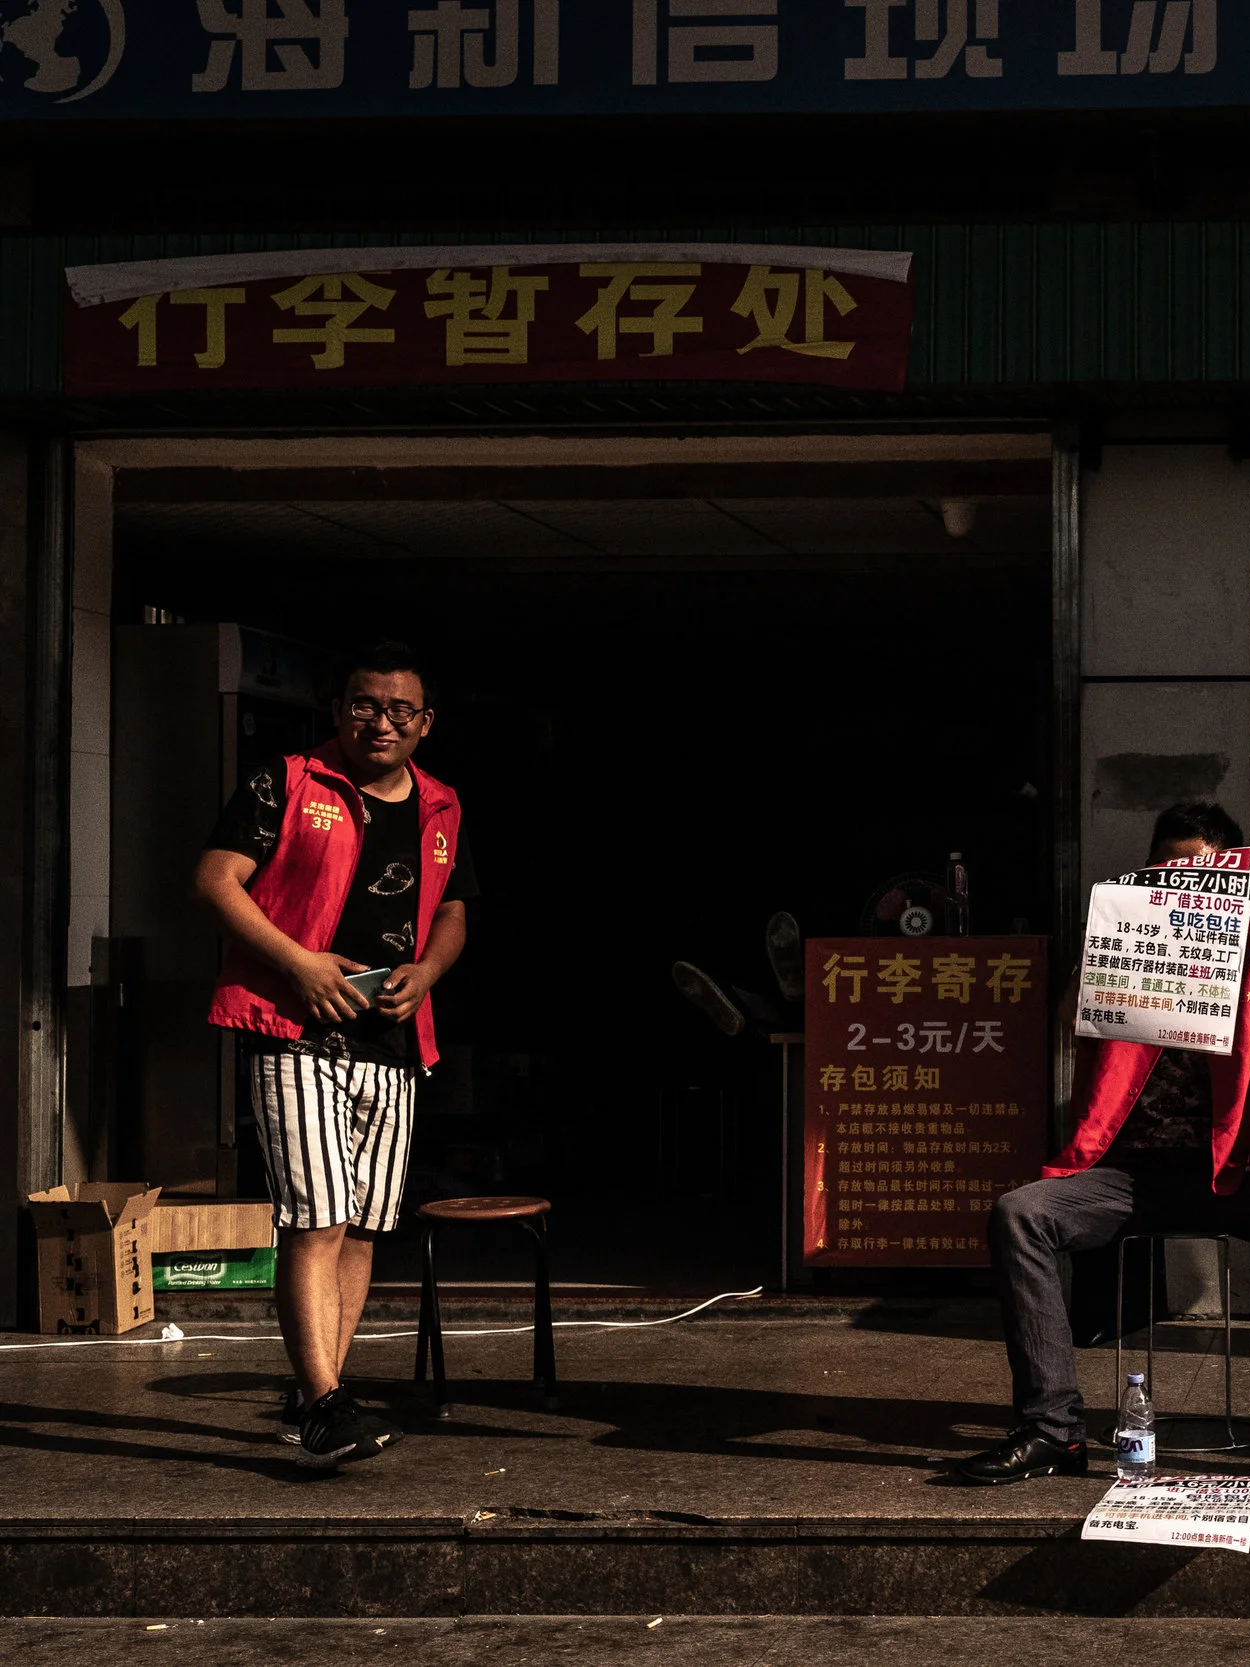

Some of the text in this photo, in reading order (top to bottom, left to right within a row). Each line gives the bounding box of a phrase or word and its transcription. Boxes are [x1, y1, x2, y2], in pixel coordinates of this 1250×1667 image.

[117, 260, 857, 370] 行李暂存处
[311, 816, 332, 831] 33
[1104, 870, 1248, 897] 价：16元/小时
[1150, 890, 1244, 915] 进厂借支100元
[1116, 921, 1240, 947] 18-45岁，本人证件有磁
[1169, 909, 1242, 934] 包吃包住
[821, 952, 1033, 1004] 行李寄存
[1086, 953, 1238, 983] 主要做医疗器材装配坐班/两班
[847, 1020, 1006, 1054] 2-3元/天
[819, 1064, 941, 1092] 存包须知
